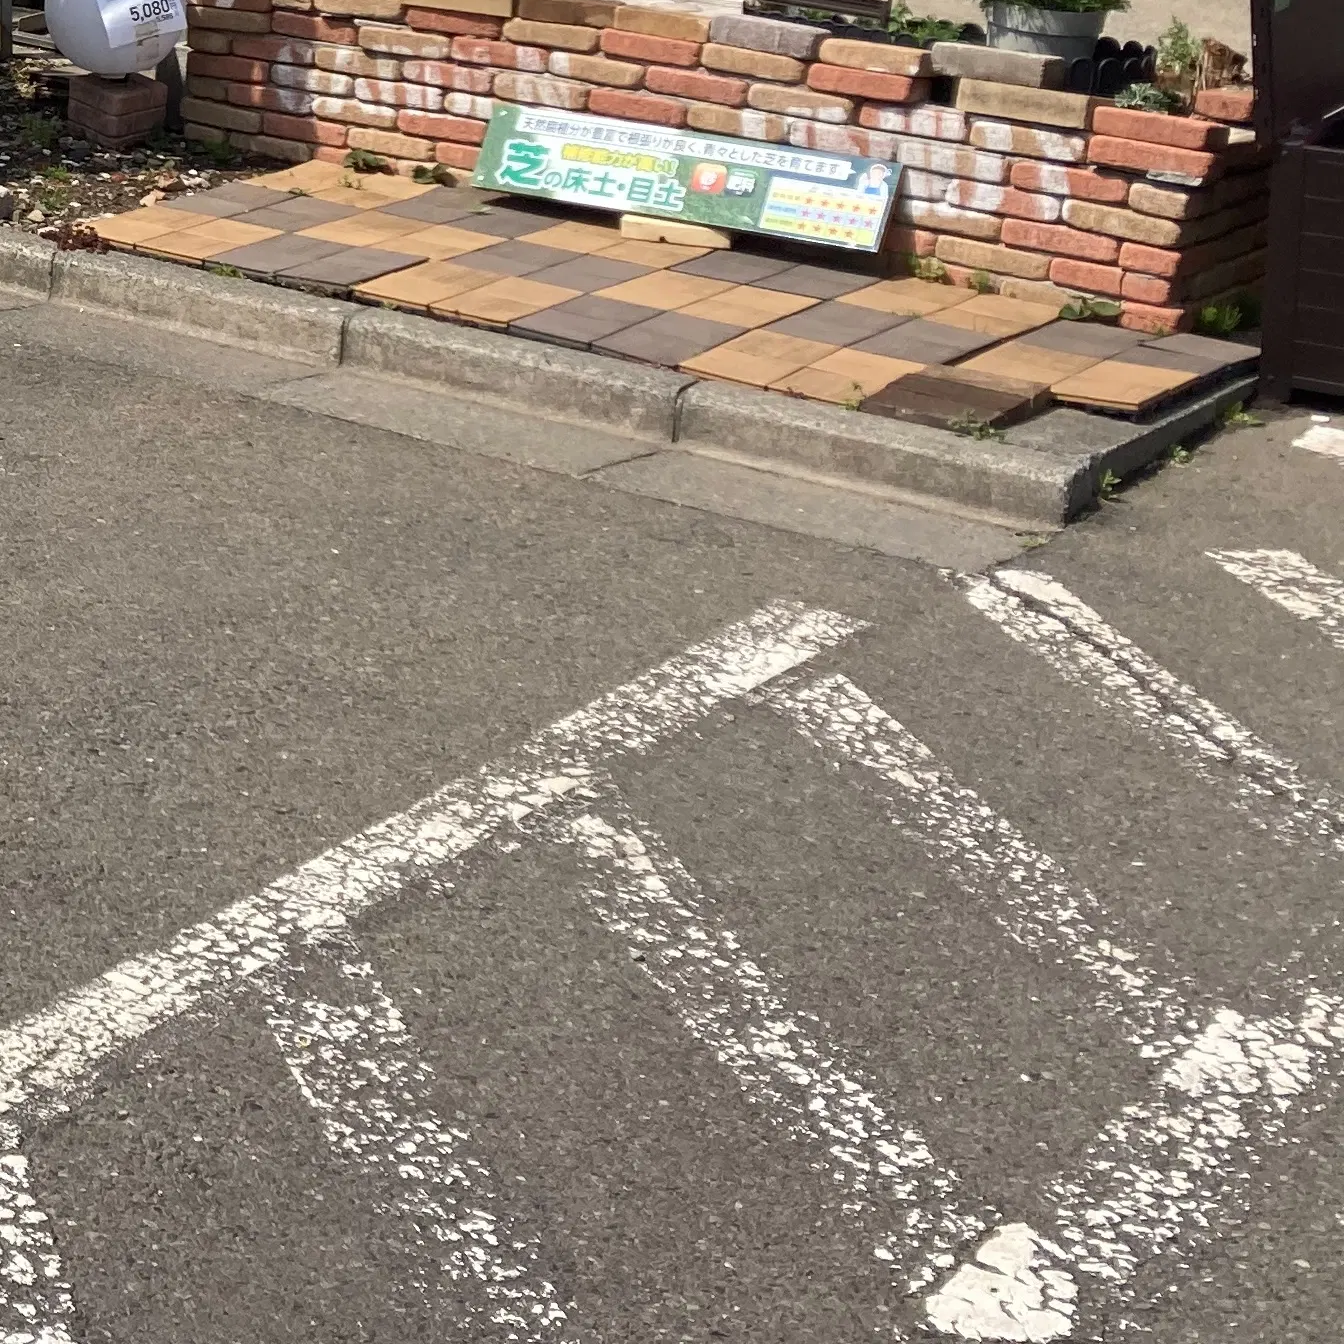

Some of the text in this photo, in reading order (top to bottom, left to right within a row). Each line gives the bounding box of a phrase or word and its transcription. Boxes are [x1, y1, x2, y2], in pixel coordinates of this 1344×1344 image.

[498, 142, 686, 209] 芝の床土・目土
